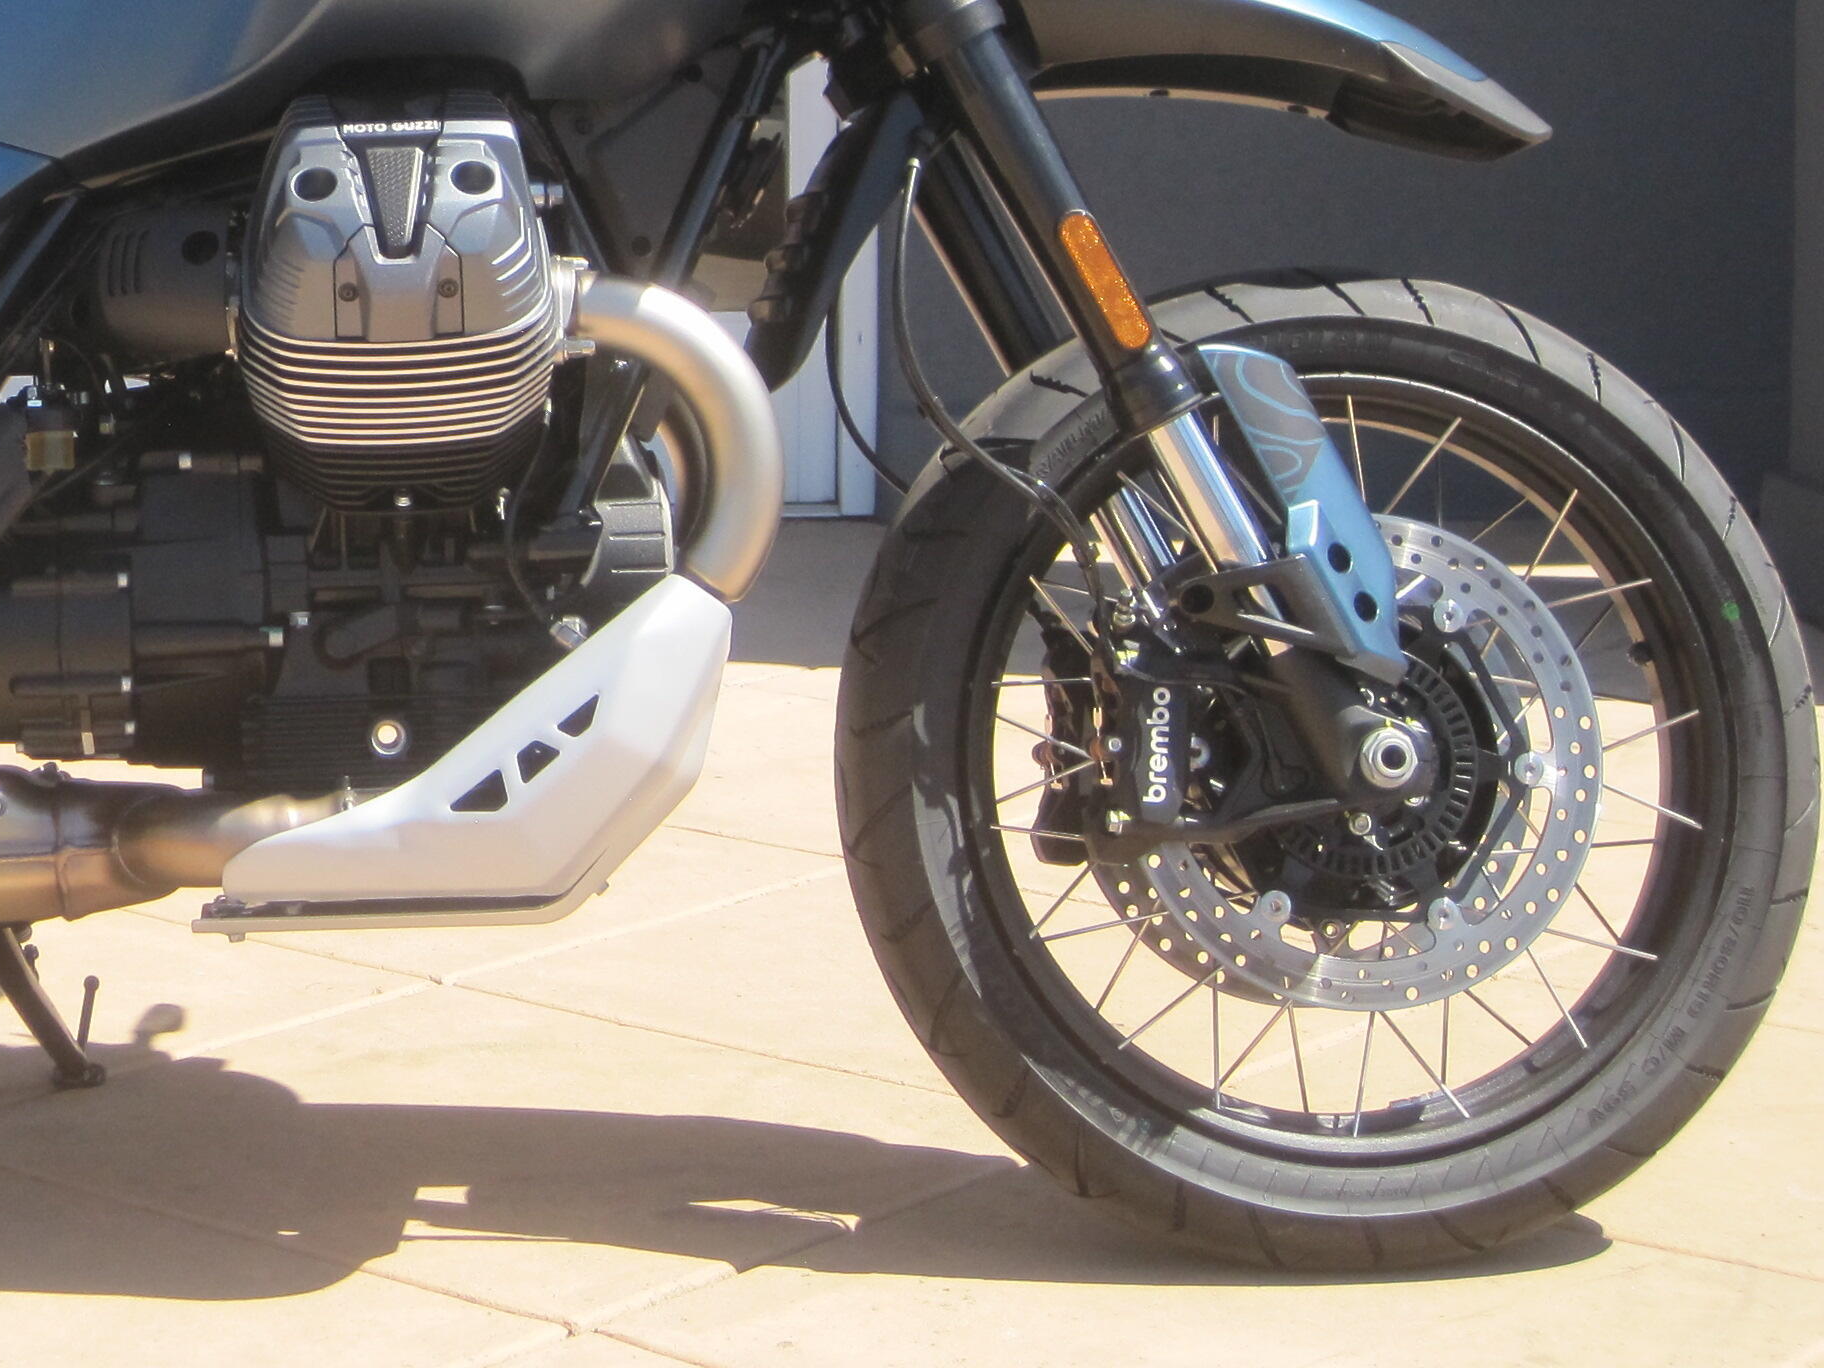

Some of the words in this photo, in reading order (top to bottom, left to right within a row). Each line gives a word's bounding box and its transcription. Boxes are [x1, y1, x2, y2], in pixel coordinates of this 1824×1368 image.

[342, 122, 388, 134] MOTO
[391, 119, 440, 132] GUZZI
[1142, 686, 1172, 804] brembo
